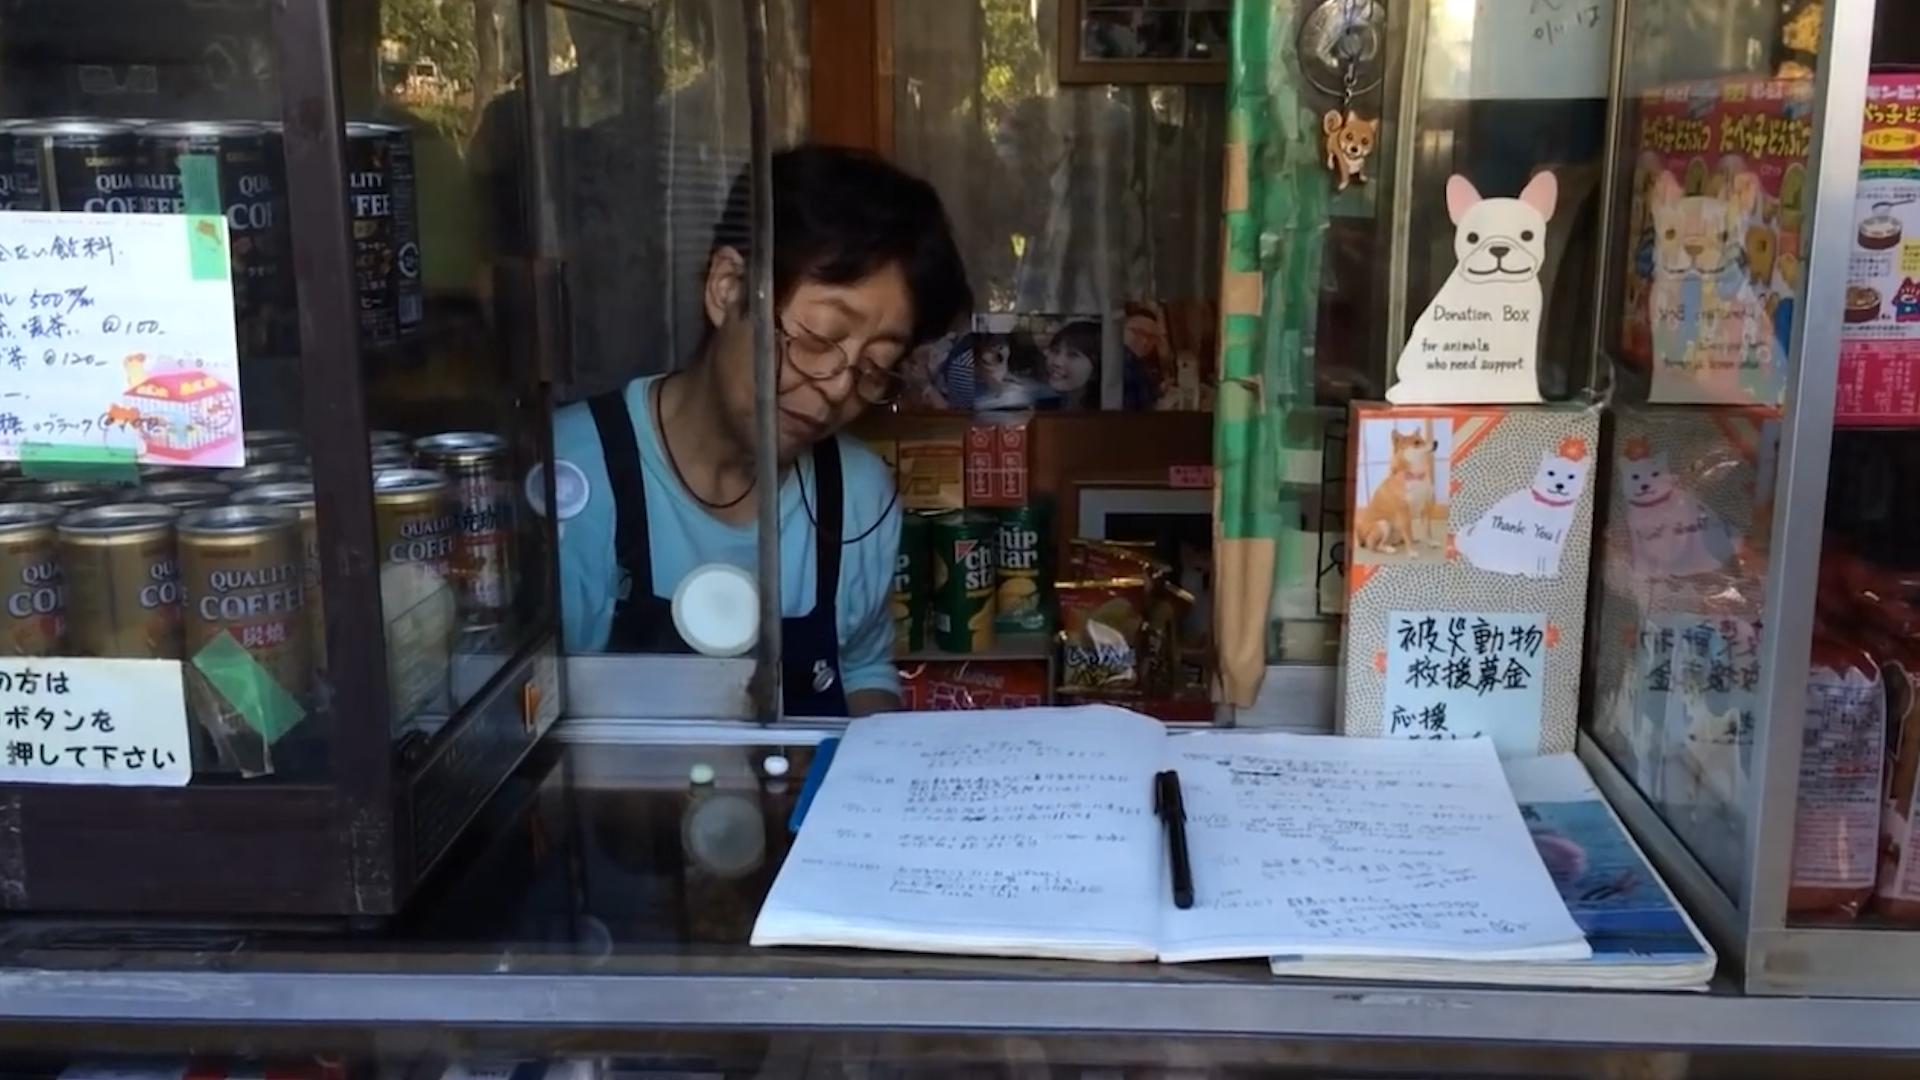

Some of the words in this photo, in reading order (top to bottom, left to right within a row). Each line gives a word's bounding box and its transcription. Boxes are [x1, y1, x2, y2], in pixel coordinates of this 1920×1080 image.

[1433, 305, 1493, 322] Donation
[1503, 306, 1530, 322] Box
[1421, 337, 1438, 352] for
[1443, 338, 1490, 352] animals
[1426, 358, 1447, 370] who
[1450, 356, 1477, 371] need
[1480, 357, 1524, 373] support
[1492, 515, 1525, 535] Thank
[1534, 523, 1562, 544] You!
[1398, 616, 1544, 657] 被災動物
[1405, 654, 1532, 696] 救援募金
[5, 705, 116, 733] ボタンを
[1391, 702, 1449, 733] 応援
[6, 740, 176, 770] 押して下さい
